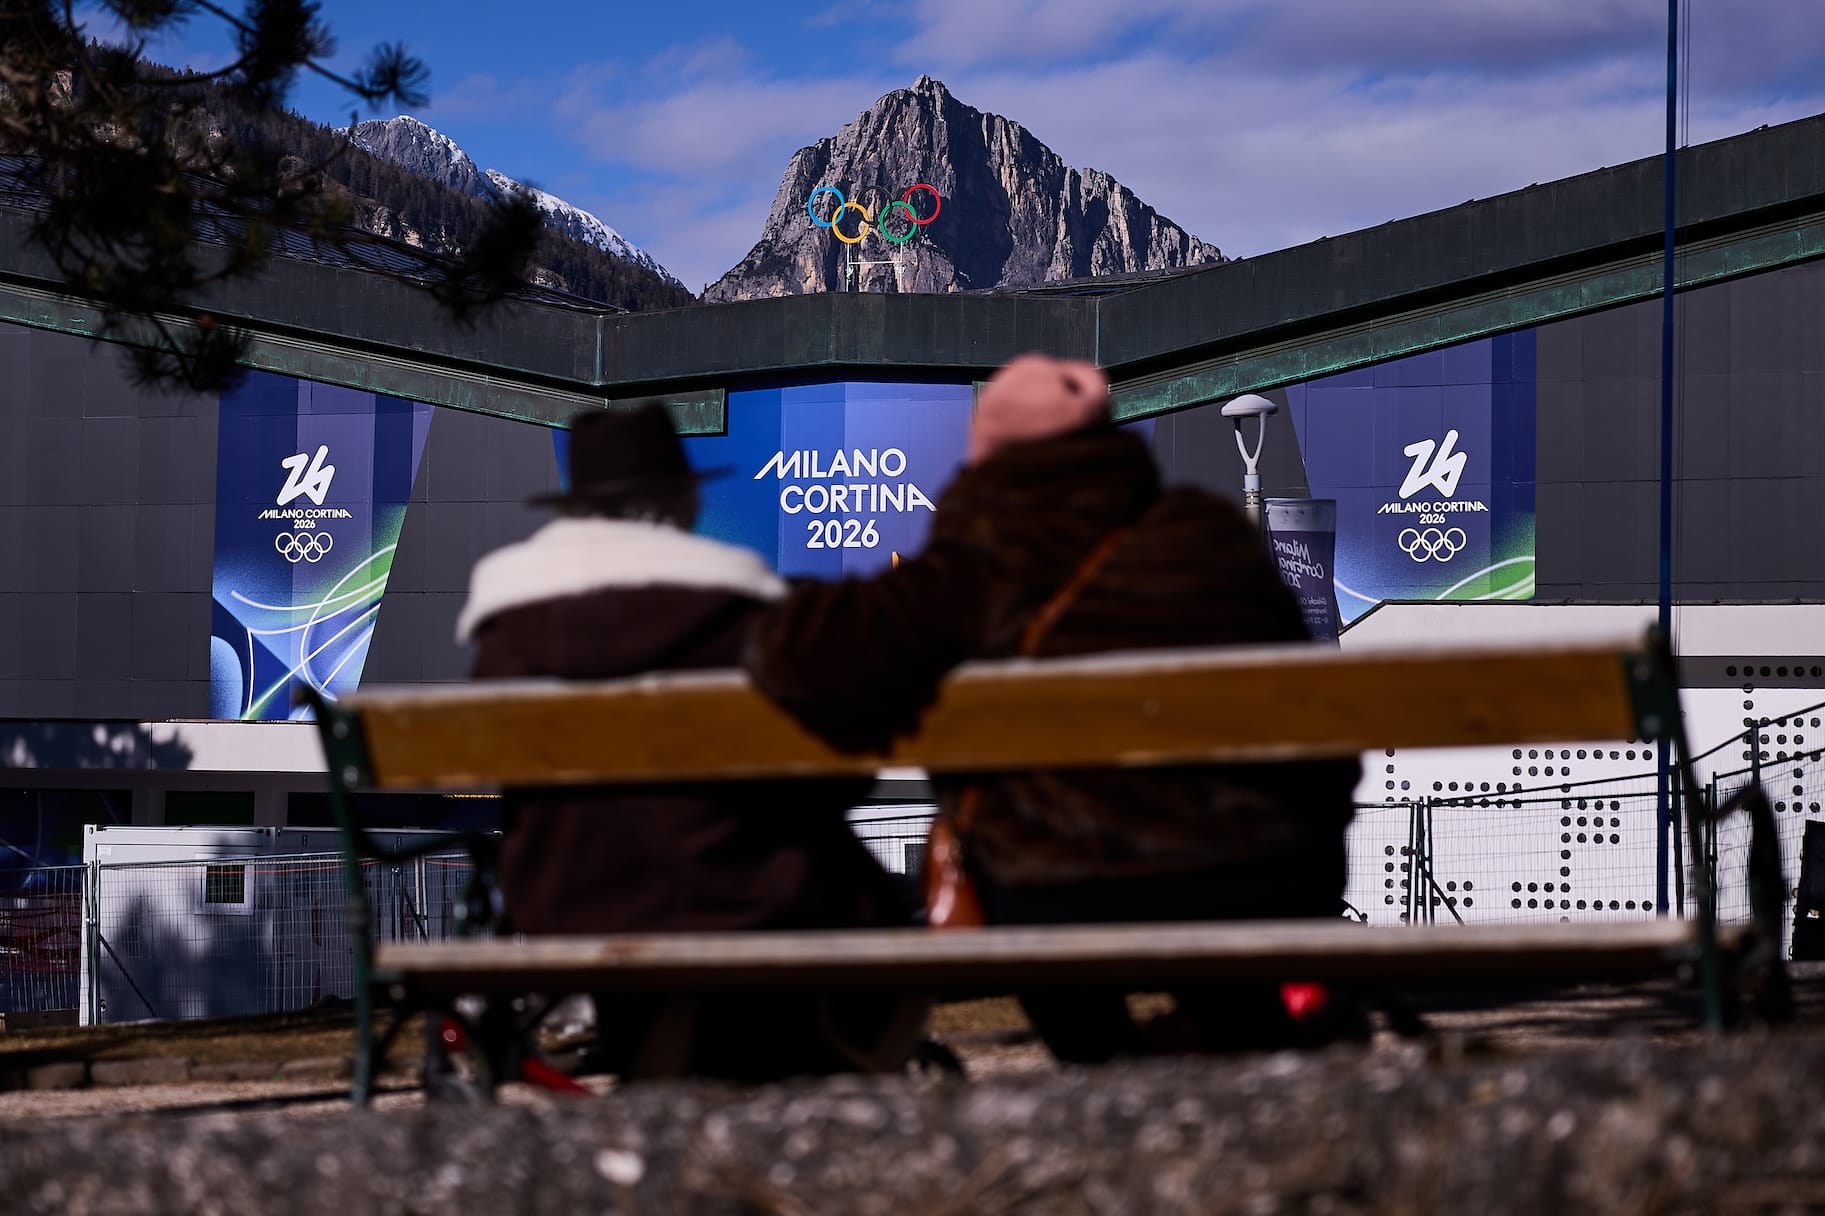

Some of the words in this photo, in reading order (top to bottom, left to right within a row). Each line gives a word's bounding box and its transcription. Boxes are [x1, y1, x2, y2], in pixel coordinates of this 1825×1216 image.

[754, 448, 907, 480] MILANO
[780, 483, 937, 514] CORTINA
[258, 509, 304, 519] MILANO
[305, 508, 352, 519] CORTINA
[1377, 502, 1431, 514] MILANO
[1433, 501, 1488, 512] CORTINA
[293, 519, 316, 529] 2026
[1419, 513, 1445, 524] 2026
[806, 519, 880, 549] 2026
